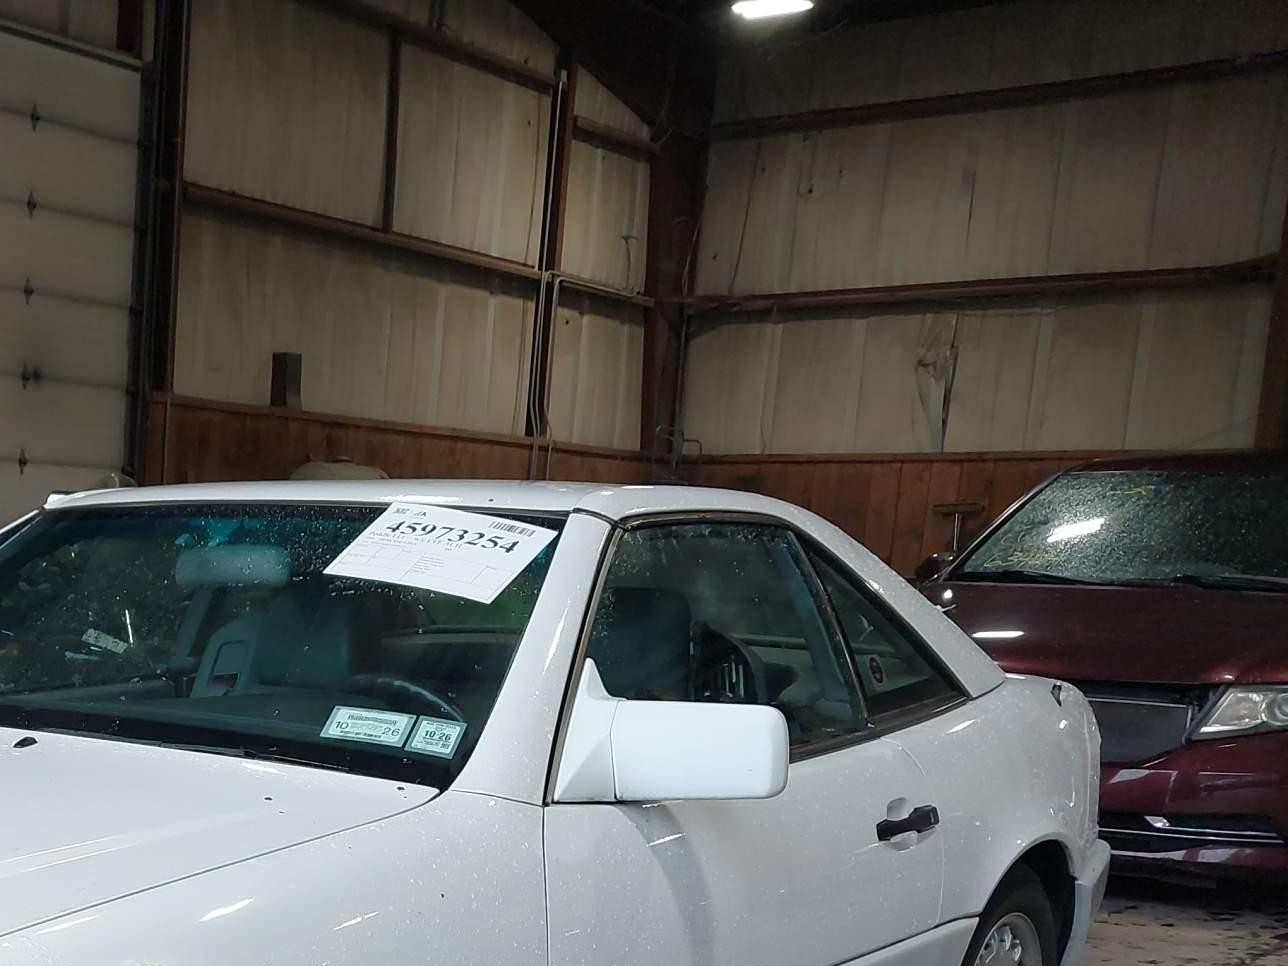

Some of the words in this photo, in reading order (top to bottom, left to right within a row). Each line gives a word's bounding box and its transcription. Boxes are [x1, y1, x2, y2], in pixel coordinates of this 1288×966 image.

[386, 520, 520, 553] 45973254
[335, 720, 349, 730] 10
[382, 727, 400, 737] 26
